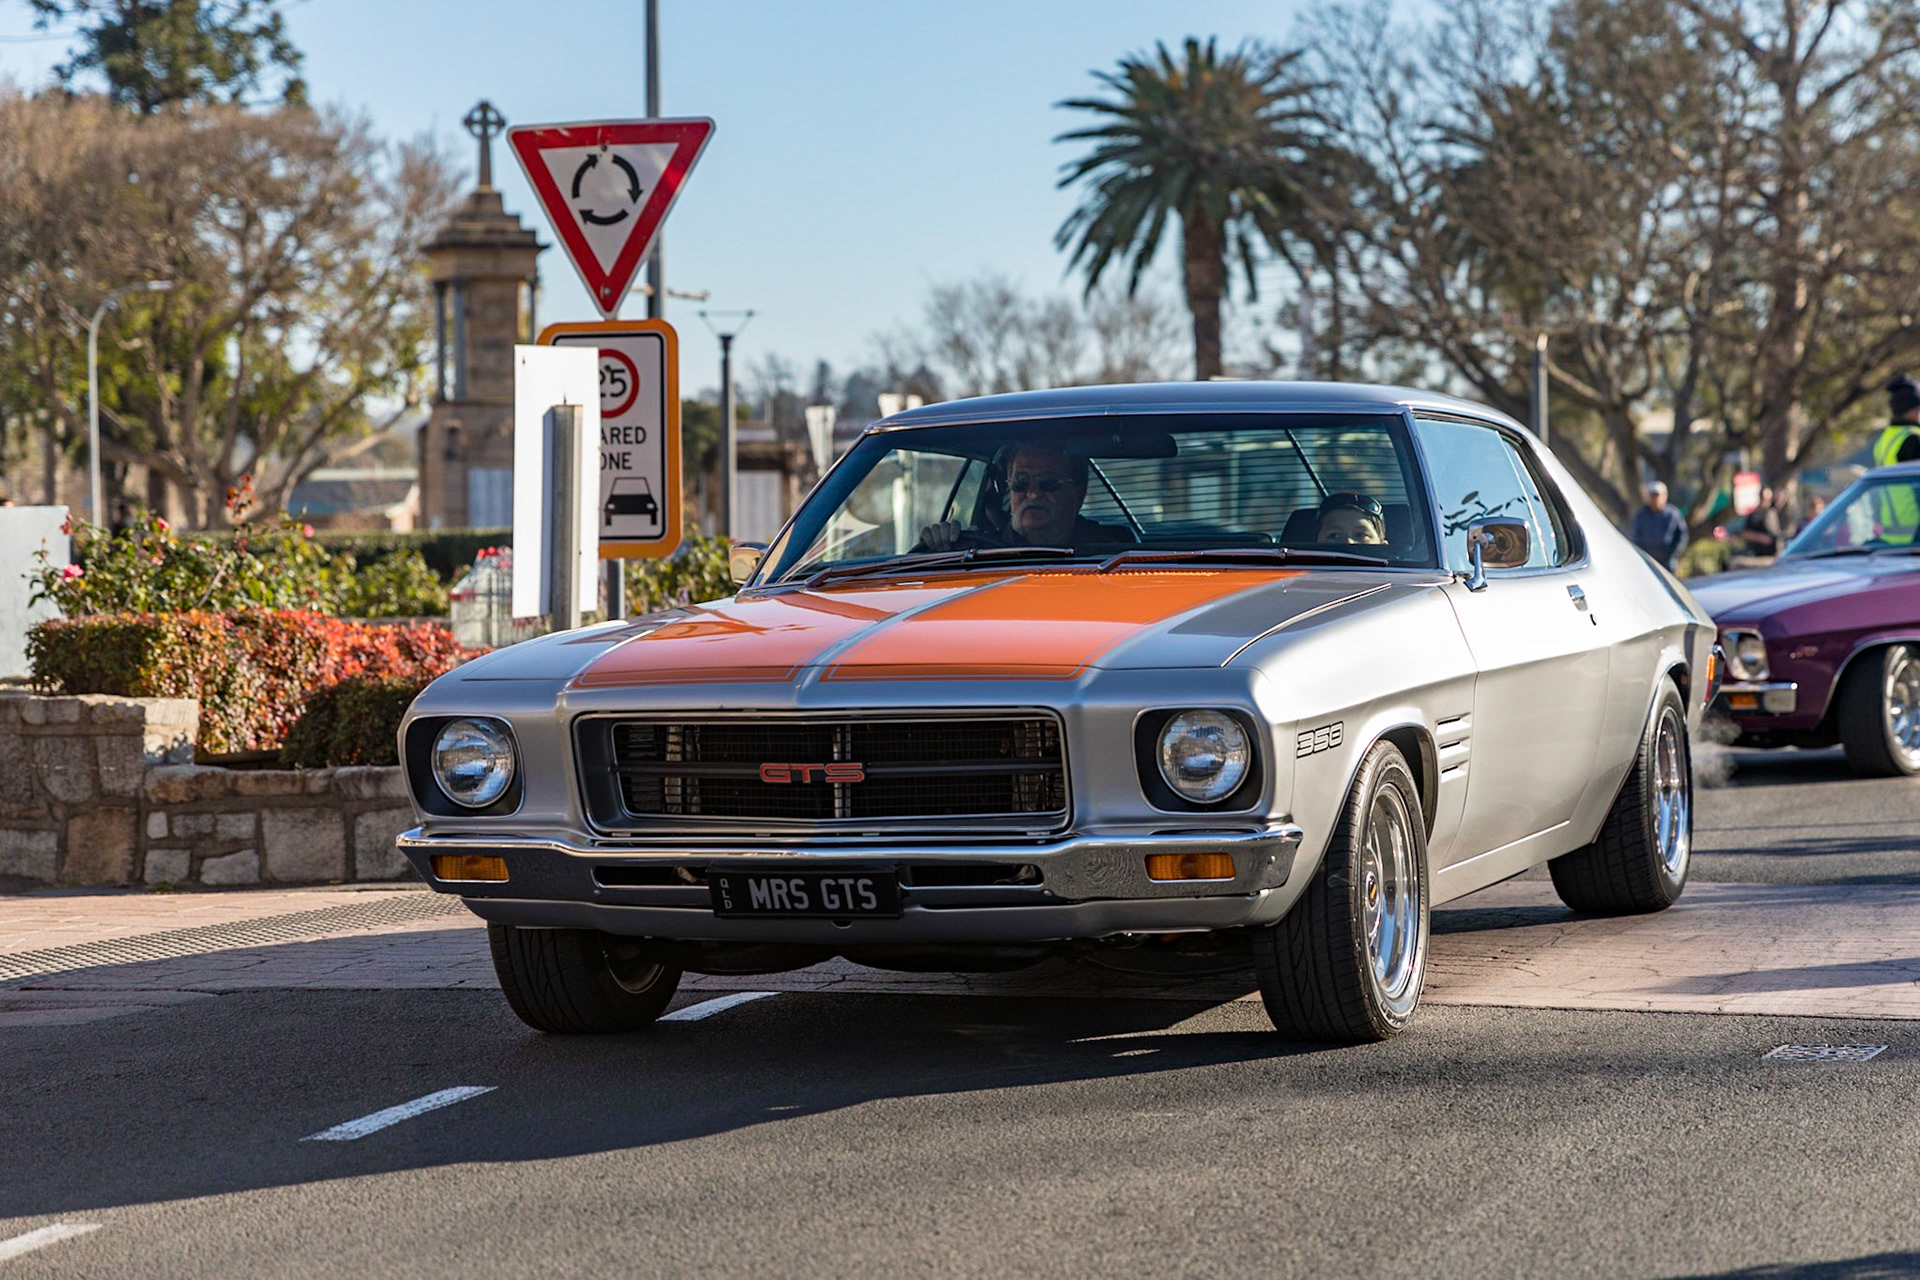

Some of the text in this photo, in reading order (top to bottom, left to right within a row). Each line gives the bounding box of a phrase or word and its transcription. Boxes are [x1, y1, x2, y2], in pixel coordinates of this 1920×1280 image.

[1296, 721, 1345, 759] 350
[760, 763, 865, 783] GTS
[719, 878, 733, 910] QLD
[748, 878, 878, 910] MRS GTS
